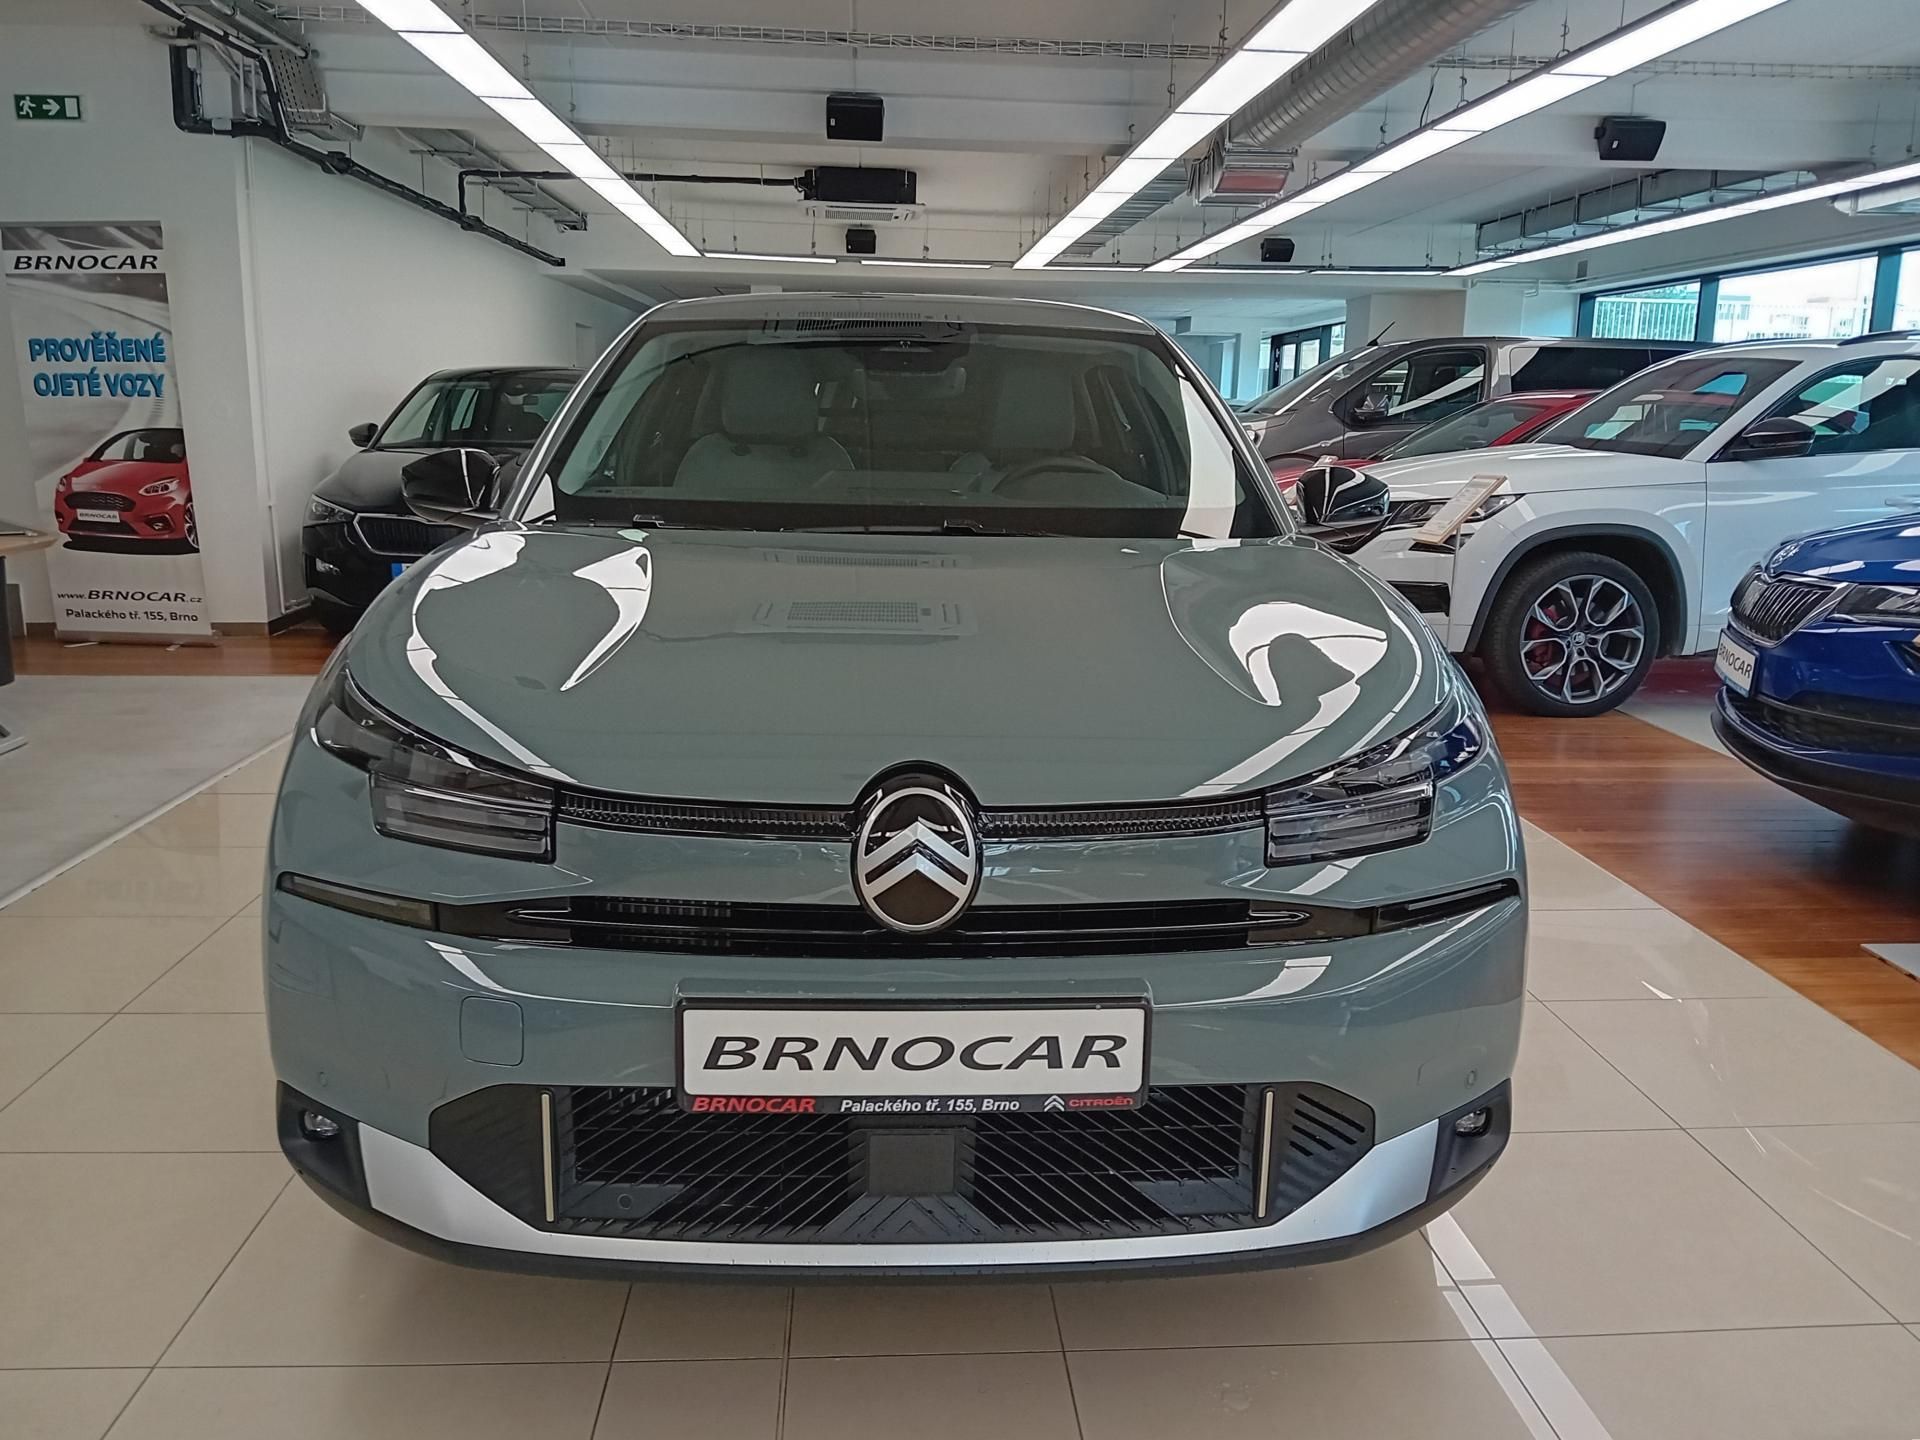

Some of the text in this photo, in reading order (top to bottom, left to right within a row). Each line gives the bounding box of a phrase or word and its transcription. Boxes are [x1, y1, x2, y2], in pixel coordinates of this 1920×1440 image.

[13, 255, 158, 270] BRNOCAR
[28, 331, 167, 362] PROVĚŘENÉ
[33, 366, 165, 397] OJETÉ VOZY
[79, 512, 118, 520] BRNOCAR
[57, 590, 203, 603] www.BRNOCAR.cz
[66, 609, 199, 622] Palackého tř. 155, Brno
[1718, 643, 1753, 679] BRNOCAR
[703, 1035, 1127, 1071] BRNOCAR
[692, 1098, 816, 1112] BRNOCAR
[840, 1098, 922, 1113] Palackého
[925, 1099, 941, 1112] tř.
[947, 1099, 977, 1114] 155,
[982, 1099, 1020, 1112] Brno
